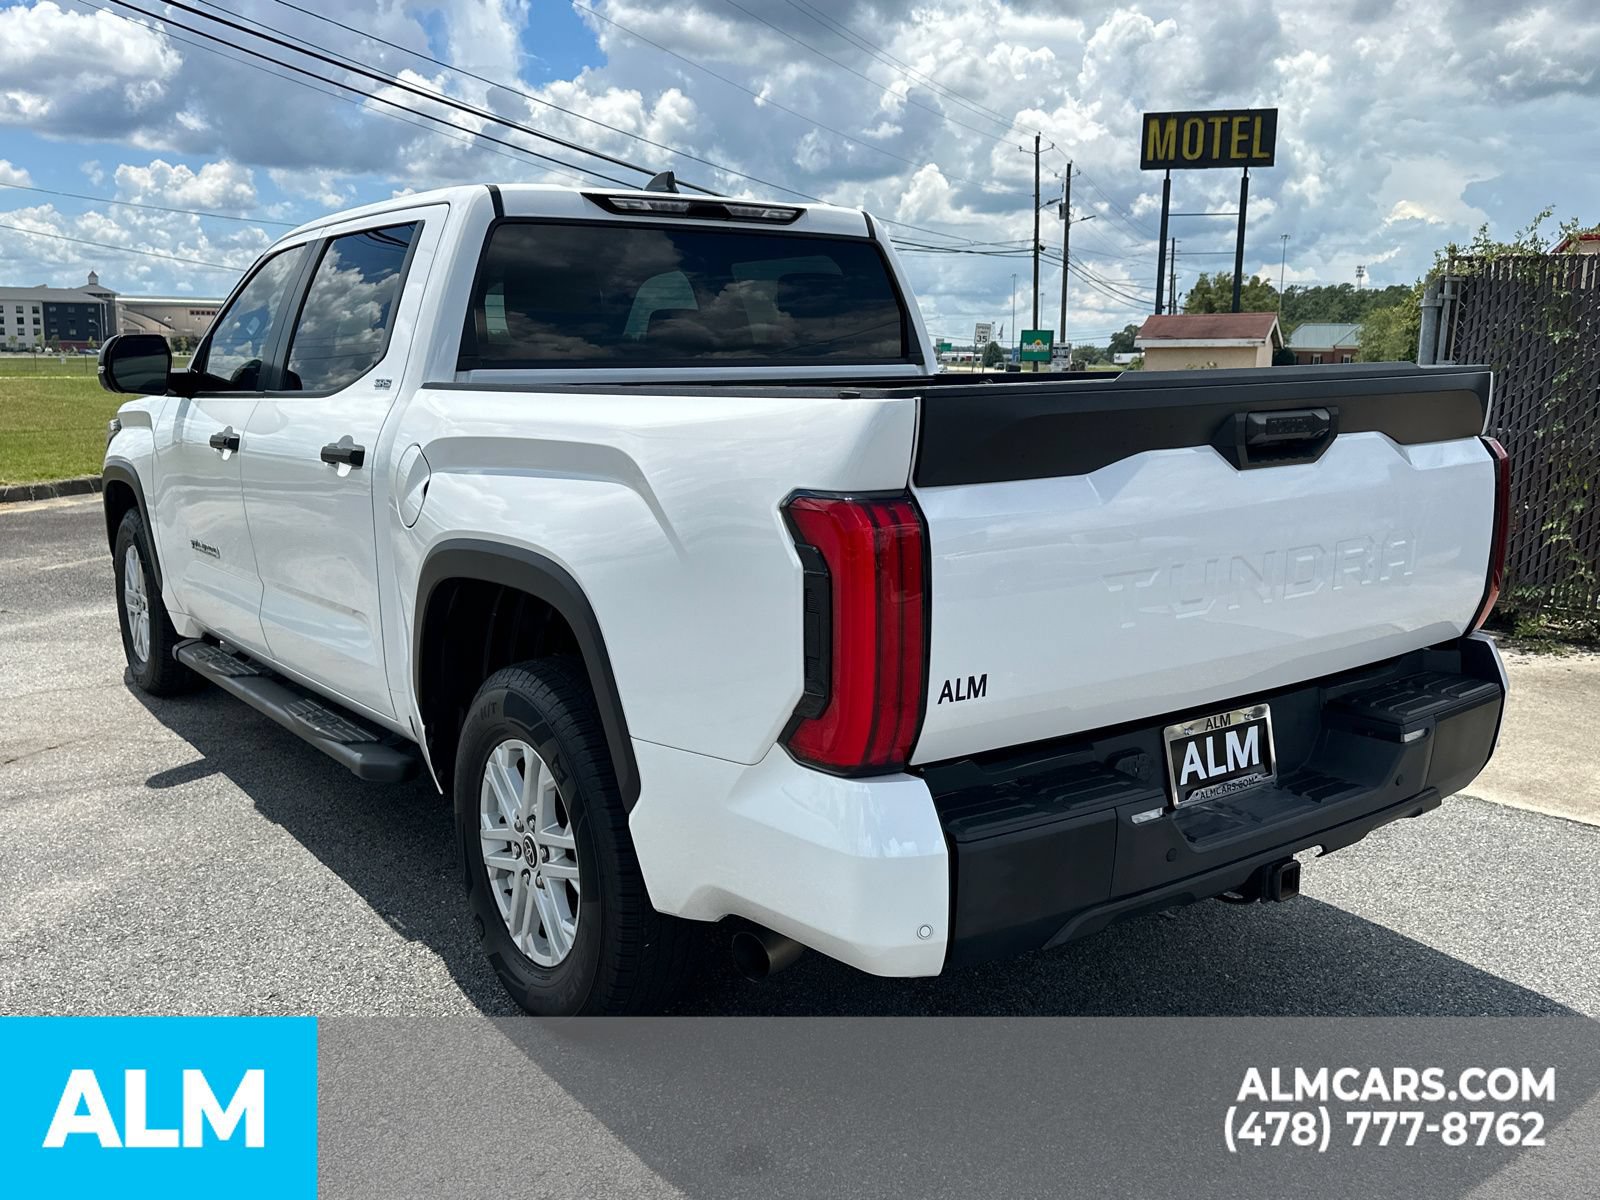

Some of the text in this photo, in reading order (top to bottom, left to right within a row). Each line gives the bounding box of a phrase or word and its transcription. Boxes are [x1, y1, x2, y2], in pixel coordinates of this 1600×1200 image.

[1146, 116, 1270, 161] MOTEL
[976, 335, 988, 343] 35
[1098, 531, 1416, 629] TUNDRA
[937, 673, 988, 705] ALM
[1205, 713, 1232, 731] ALM
[1180, 725, 1260, 786] ALM
[1199, 778, 1255, 800] ALMCARS.COM
